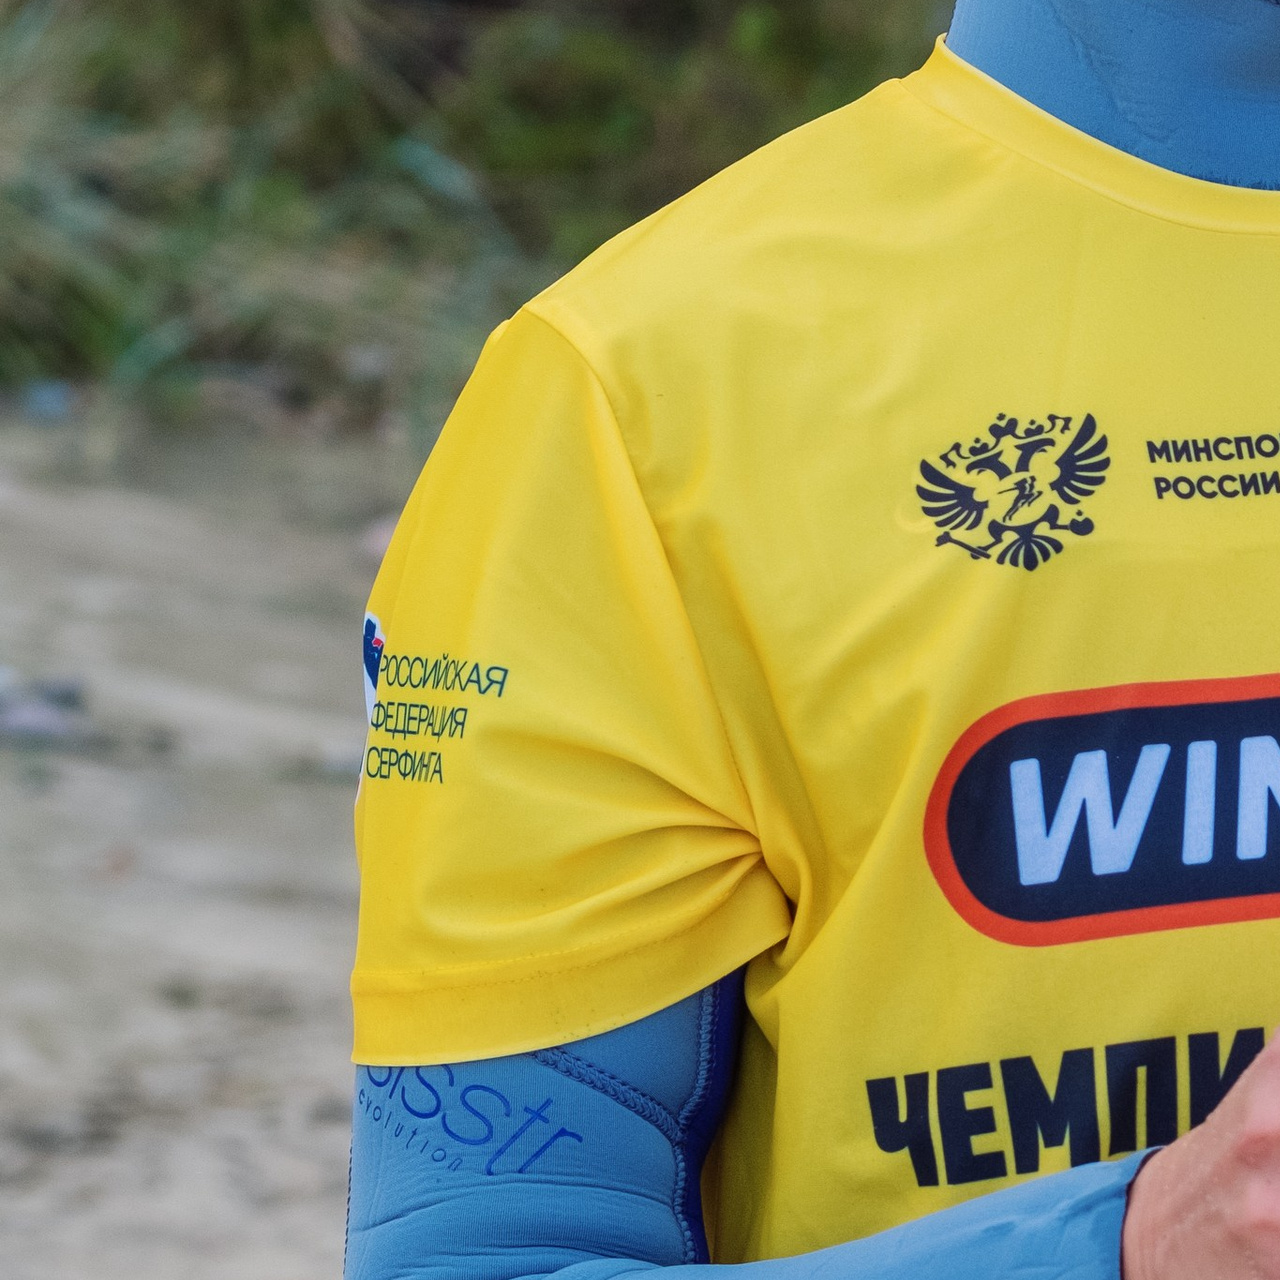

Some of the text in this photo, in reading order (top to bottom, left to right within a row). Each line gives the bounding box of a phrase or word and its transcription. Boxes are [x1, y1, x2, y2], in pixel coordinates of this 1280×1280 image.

[380, 653, 509, 698] РОССИЙСКАЯ
[370, 700, 468, 743] ФЕДЕРАЦИЯ
[366, 746, 444, 784] СЕРФИНГА
[865, 1026, 1266, 1187] ЧЕМПИ
[358, 1087, 464, 1172] evolution
